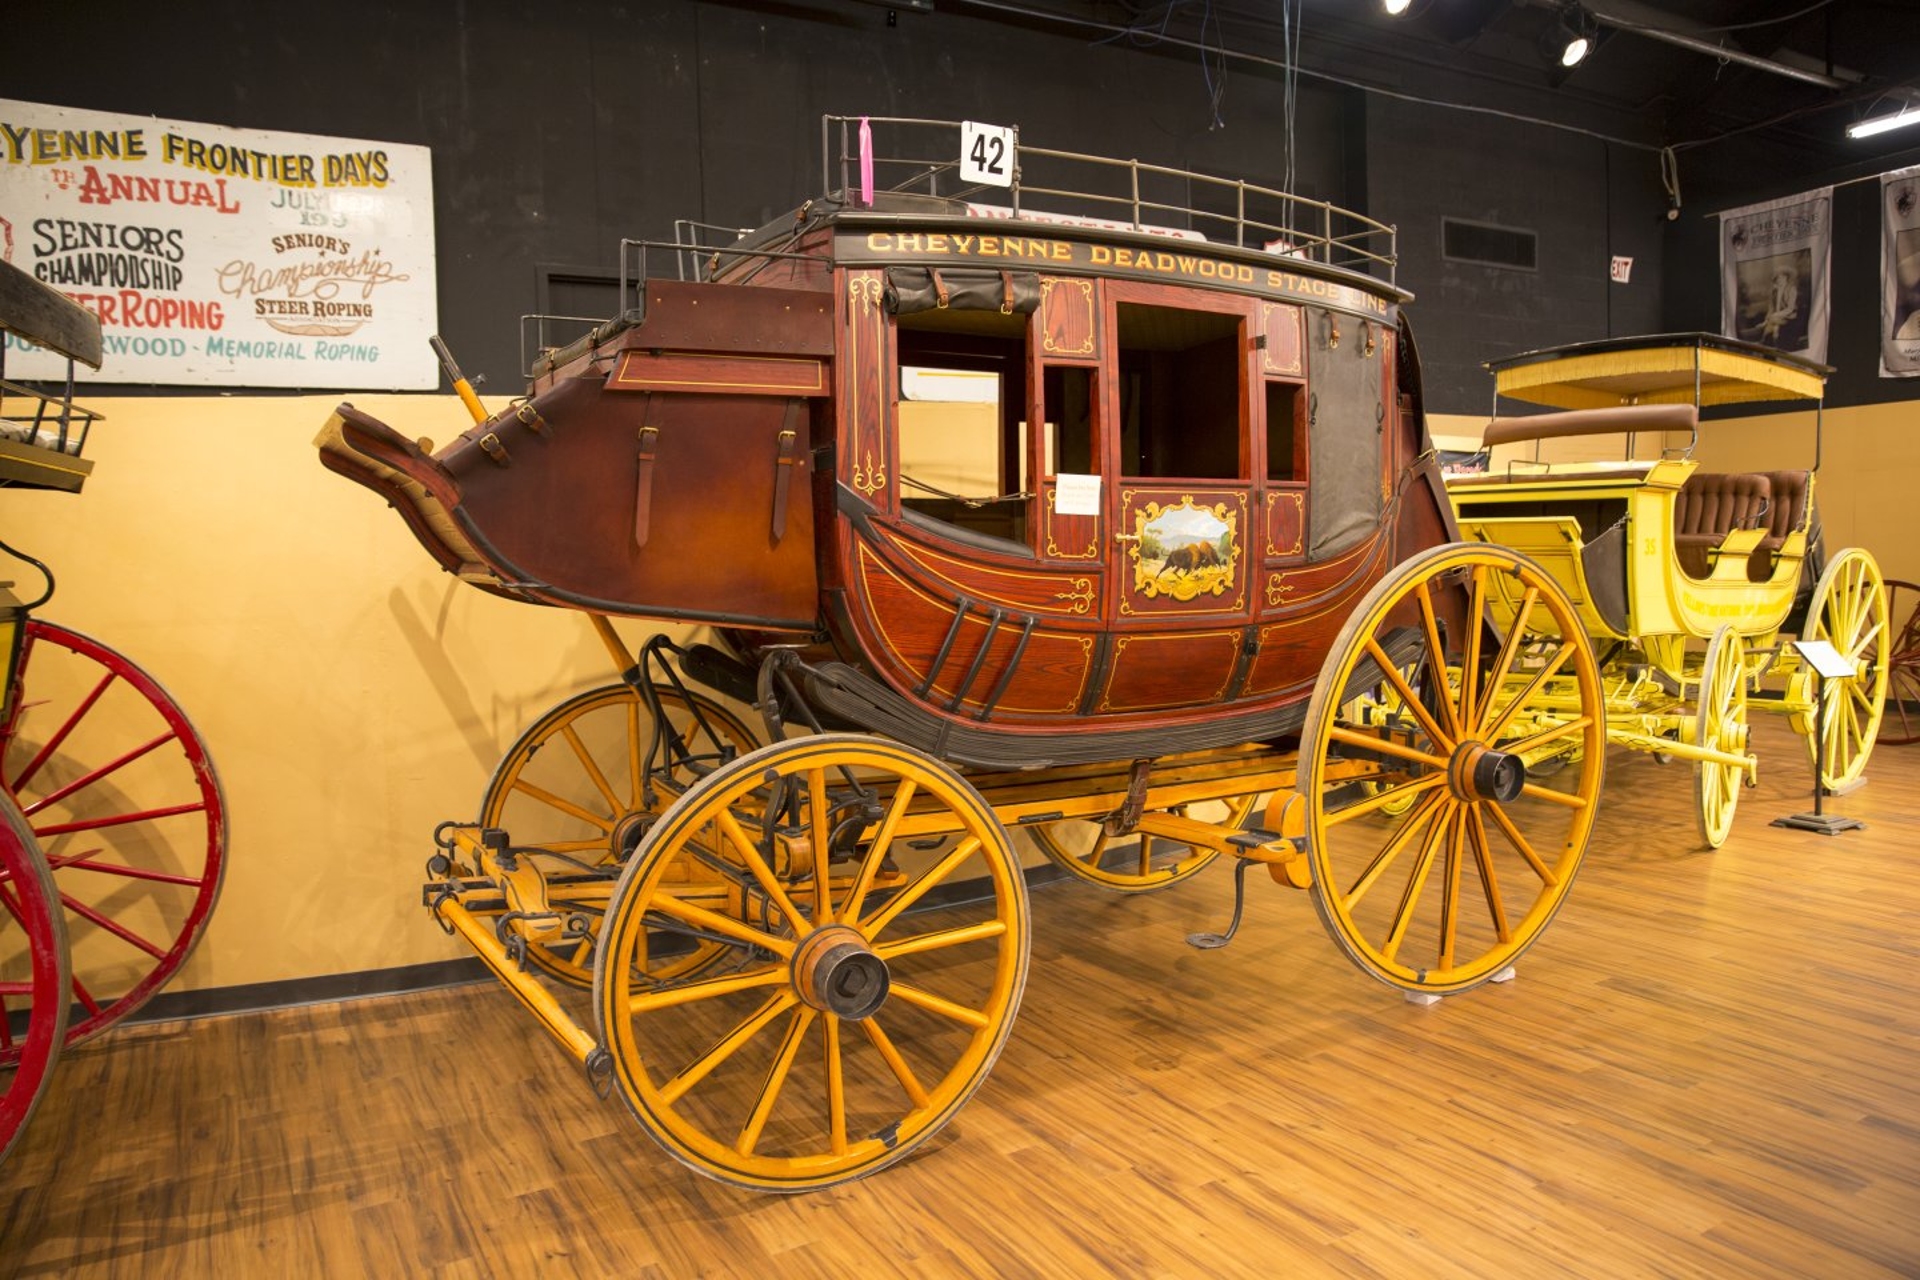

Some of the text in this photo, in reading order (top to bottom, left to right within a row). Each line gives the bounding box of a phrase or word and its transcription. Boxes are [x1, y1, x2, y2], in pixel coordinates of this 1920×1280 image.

[0, 123, 390, 188] YENNE FRONTIER DAYS
[969, 133, 1006, 176] 42
[79, 165, 240, 214] ANNUAL
[32, 218, 184, 262] SENIORS
[271, 233, 351, 255] SENIOR'S
[34, 253, 183, 291] CHAMPIONSHIP
[214, 249, 410, 300] Championship
[867, 232, 1388, 316] CHEYENNE DEADWOOD STAGE LINE
[1612, 259, 1630, 279] EXIT
[118, 289, 225, 330] ROPING
[255, 298, 373, 318] STEER ROPING
[206, 335, 307, 360] MEMORIAL
[315, 340, 380, 362] ROPING
